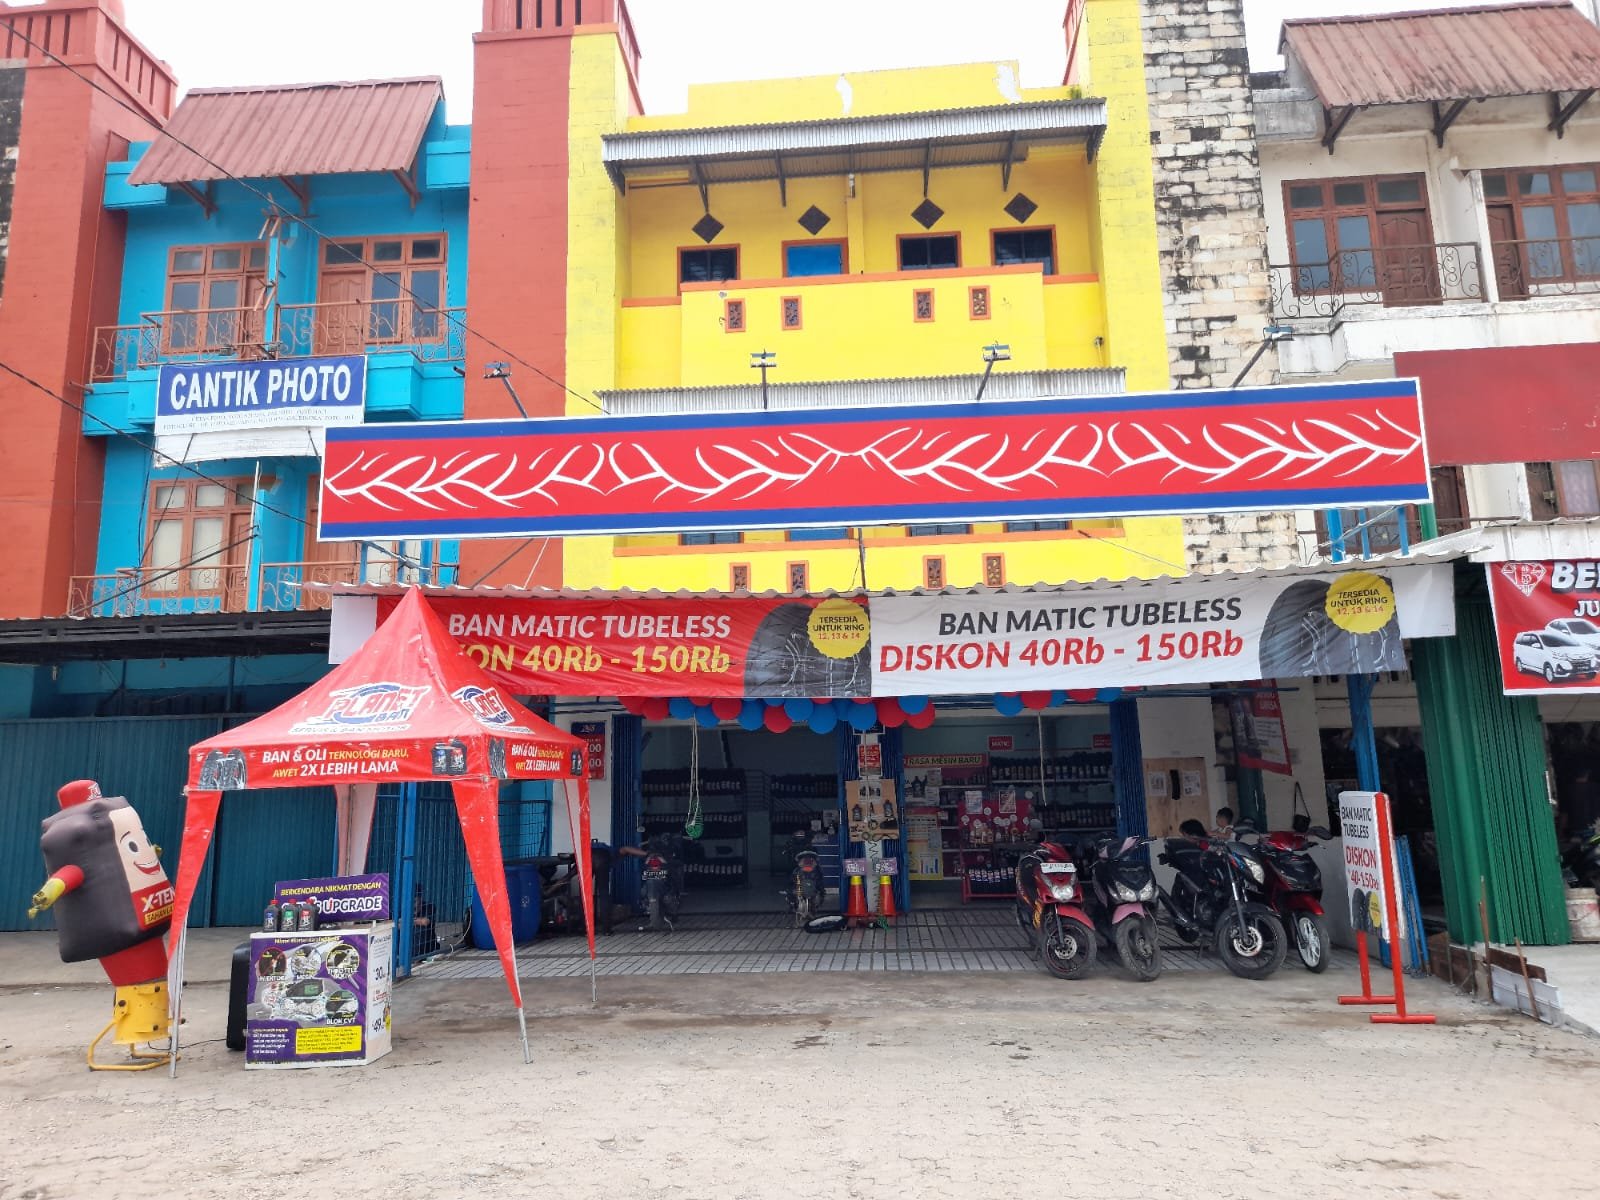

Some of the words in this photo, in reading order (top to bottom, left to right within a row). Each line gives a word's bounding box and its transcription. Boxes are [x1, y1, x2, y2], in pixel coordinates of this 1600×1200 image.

[170, 369, 261, 411] CANTIK
[266, 364, 351, 404] PHOTO
[1552, 560, 1600, 589] BE
[1336, 588, 1380, 599] TERSEDIA
[1330, 599, 1363, 608] UNTUK
[1365, 596, 1388, 605] RING
[938, 611, 998, 636] BAN
[1005, 606, 1096, 633] MATIC
[1102, 597, 1243, 628] TUBELESS
[1336, 607, 1349, 616] 12,
[1351, 606, 1362, 615] 13
[449, 613, 505, 637] BAN
[511, 614, 597, 638] MATIC
[601, 615, 731, 638] TUBELESS
[819, 615, 858, 624] TERSEDIA
[813, 624, 842, 632] UNTUK
[844, 623, 865, 631] RING
[818, 632, 829, 640] 12,
[831, 632, 841, 640] 13
[460, 643, 515, 672] ON
[522, 644, 603, 673] 40Rb
[631, 645, 730, 673] 150Rb
[879, 641, 1011, 673] DISKON
[1018, 636, 1105, 667] 40Rb
[1136, 629, 1244, 663] 150Rb
[322, 686, 430, 719] PLANET
[374, 708, 410, 722] BAN
[262, 750, 290, 763] BAN
[293, 749, 302, 762] &
[305, 748, 327, 761] OLI
[328, 750, 381, 760] TEKNOLOGI
[382, 748, 409, 759] BARU,
[511, 744, 523, 756] BAN
[528, 745, 538, 757] OLI
[909, 757, 930, 765] RASA
[958, 756, 981, 764] BARU
[272, 768, 298, 778] AWET
[300, 764, 318, 777] 2X
[320, 762, 357, 775] LEBIH
[361, 760, 399, 774] LAMA
[1341, 806, 1354, 820] BAN
[1353, 807, 1372, 821] MATIC
[1343, 823, 1369, 839] TUBELESS
[1345, 845, 1377, 869] DISKON
[281, 887, 324, 896] BERKENDARA
[325, 884, 352, 893] NIKMAT
[352, 881, 381, 890] DENGAN
